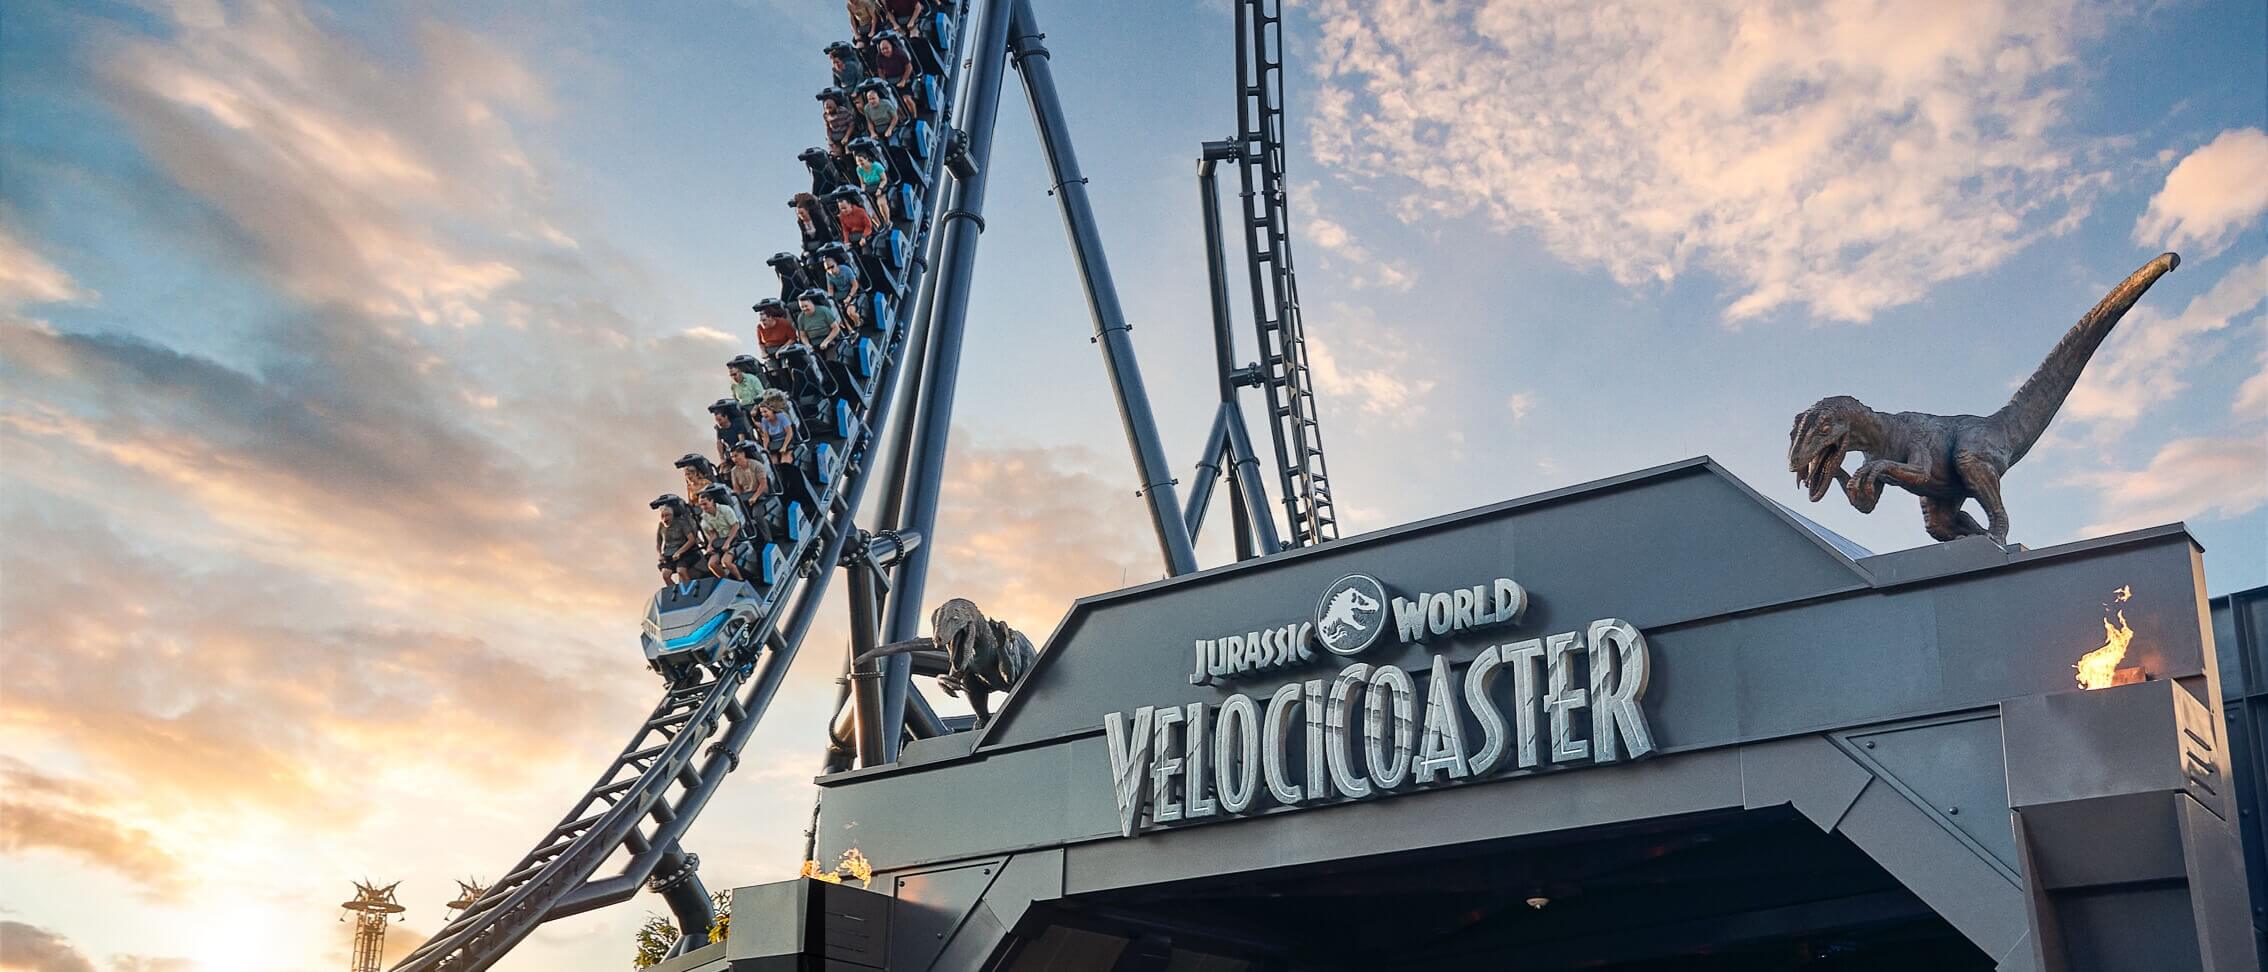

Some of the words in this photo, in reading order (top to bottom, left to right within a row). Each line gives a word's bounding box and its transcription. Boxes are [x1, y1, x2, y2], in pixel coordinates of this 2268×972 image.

[1190, 621, 1314, 684] JURASSIC
[1391, 578, 1527, 643] WORLD
[1104, 618, 1653, 838] VELOCICOASTER
